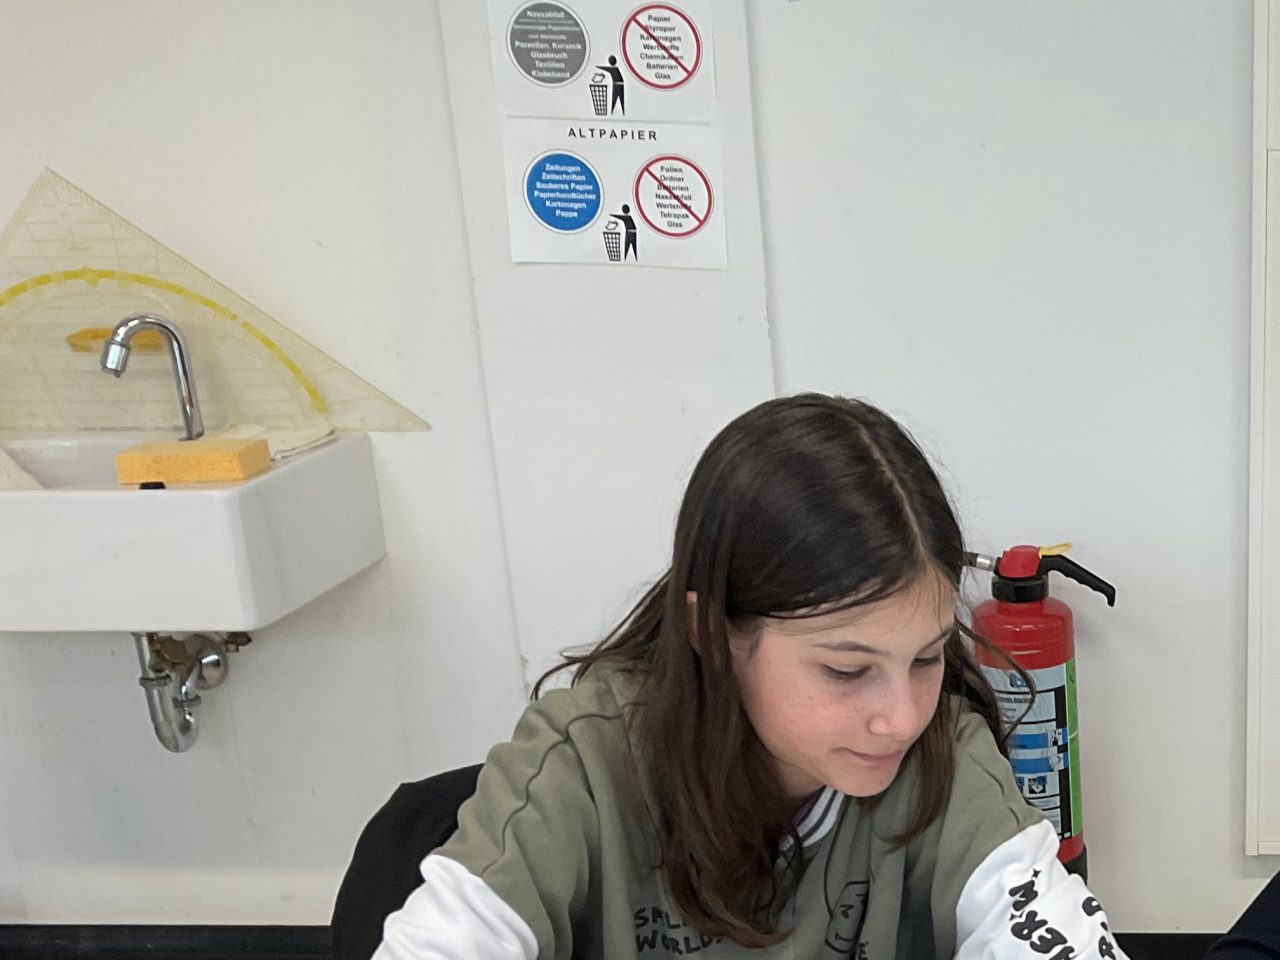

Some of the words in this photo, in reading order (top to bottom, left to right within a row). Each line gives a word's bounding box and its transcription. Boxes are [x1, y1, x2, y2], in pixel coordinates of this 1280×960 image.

[648, 15, 671, 23] Papier
[568, 127, 658, 141] ALTPAPIER
[545, 163, 581, 172] Zeitungen
[542, 172, 586, 181] Zeitschriften
[545, 200, 587, 209] Kartonagen
[555, 209, 578, 217] Pappe
